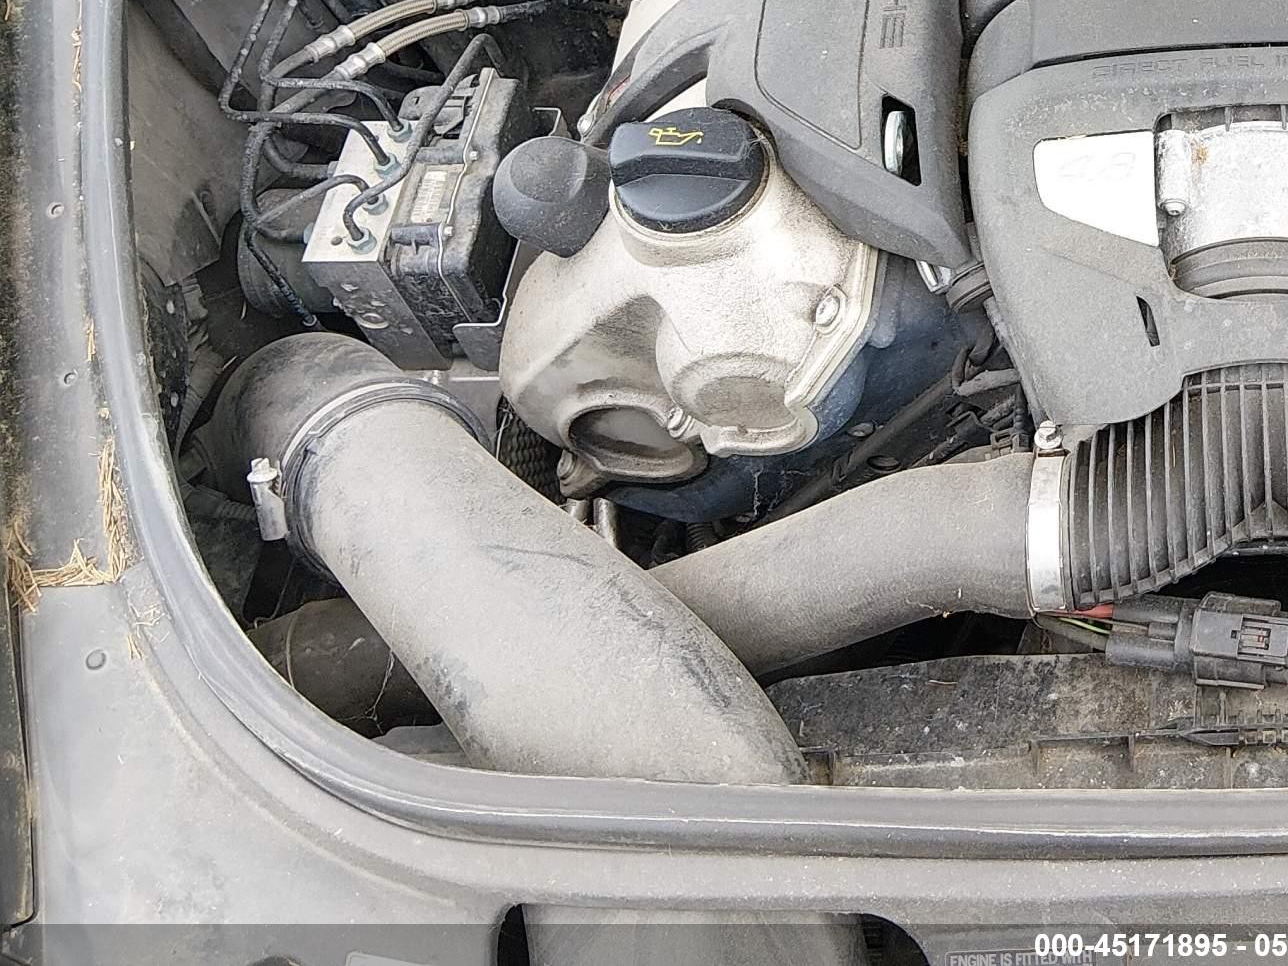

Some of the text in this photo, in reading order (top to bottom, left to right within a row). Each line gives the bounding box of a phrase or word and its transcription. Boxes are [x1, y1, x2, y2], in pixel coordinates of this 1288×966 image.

[1093, 58, 1188, 76] DIRECT
[1199, 55, 1265, 68] FUEL
[950, 954, 997, 966] ENGINE
[1001, 953, 1013, 966] IS
[1015, 951, 1058, 966] FITTED
